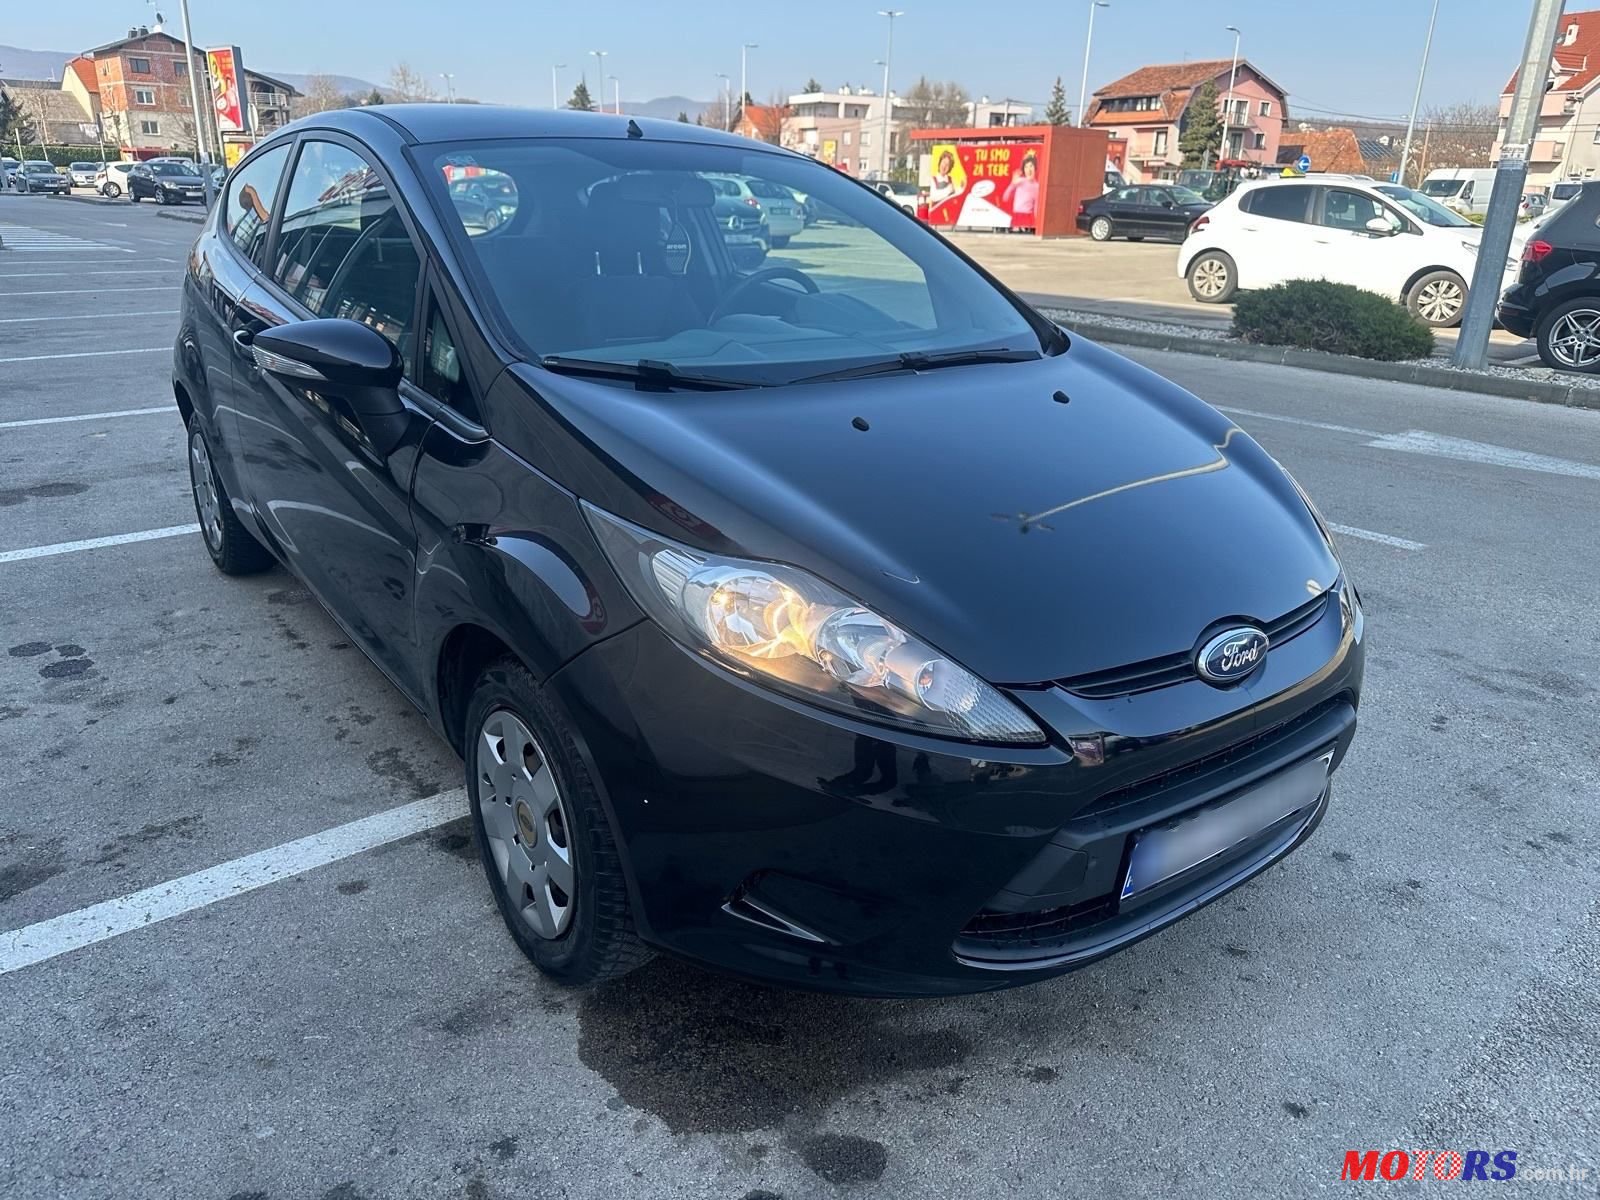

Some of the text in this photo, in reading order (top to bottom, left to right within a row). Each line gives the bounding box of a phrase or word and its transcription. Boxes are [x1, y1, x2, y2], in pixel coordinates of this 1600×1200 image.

[975, 148, 1010, 162] TU SMO
[973, 163, 1009, 176] ZA TEBE
[1221, 637, 1259, 672] Ford
